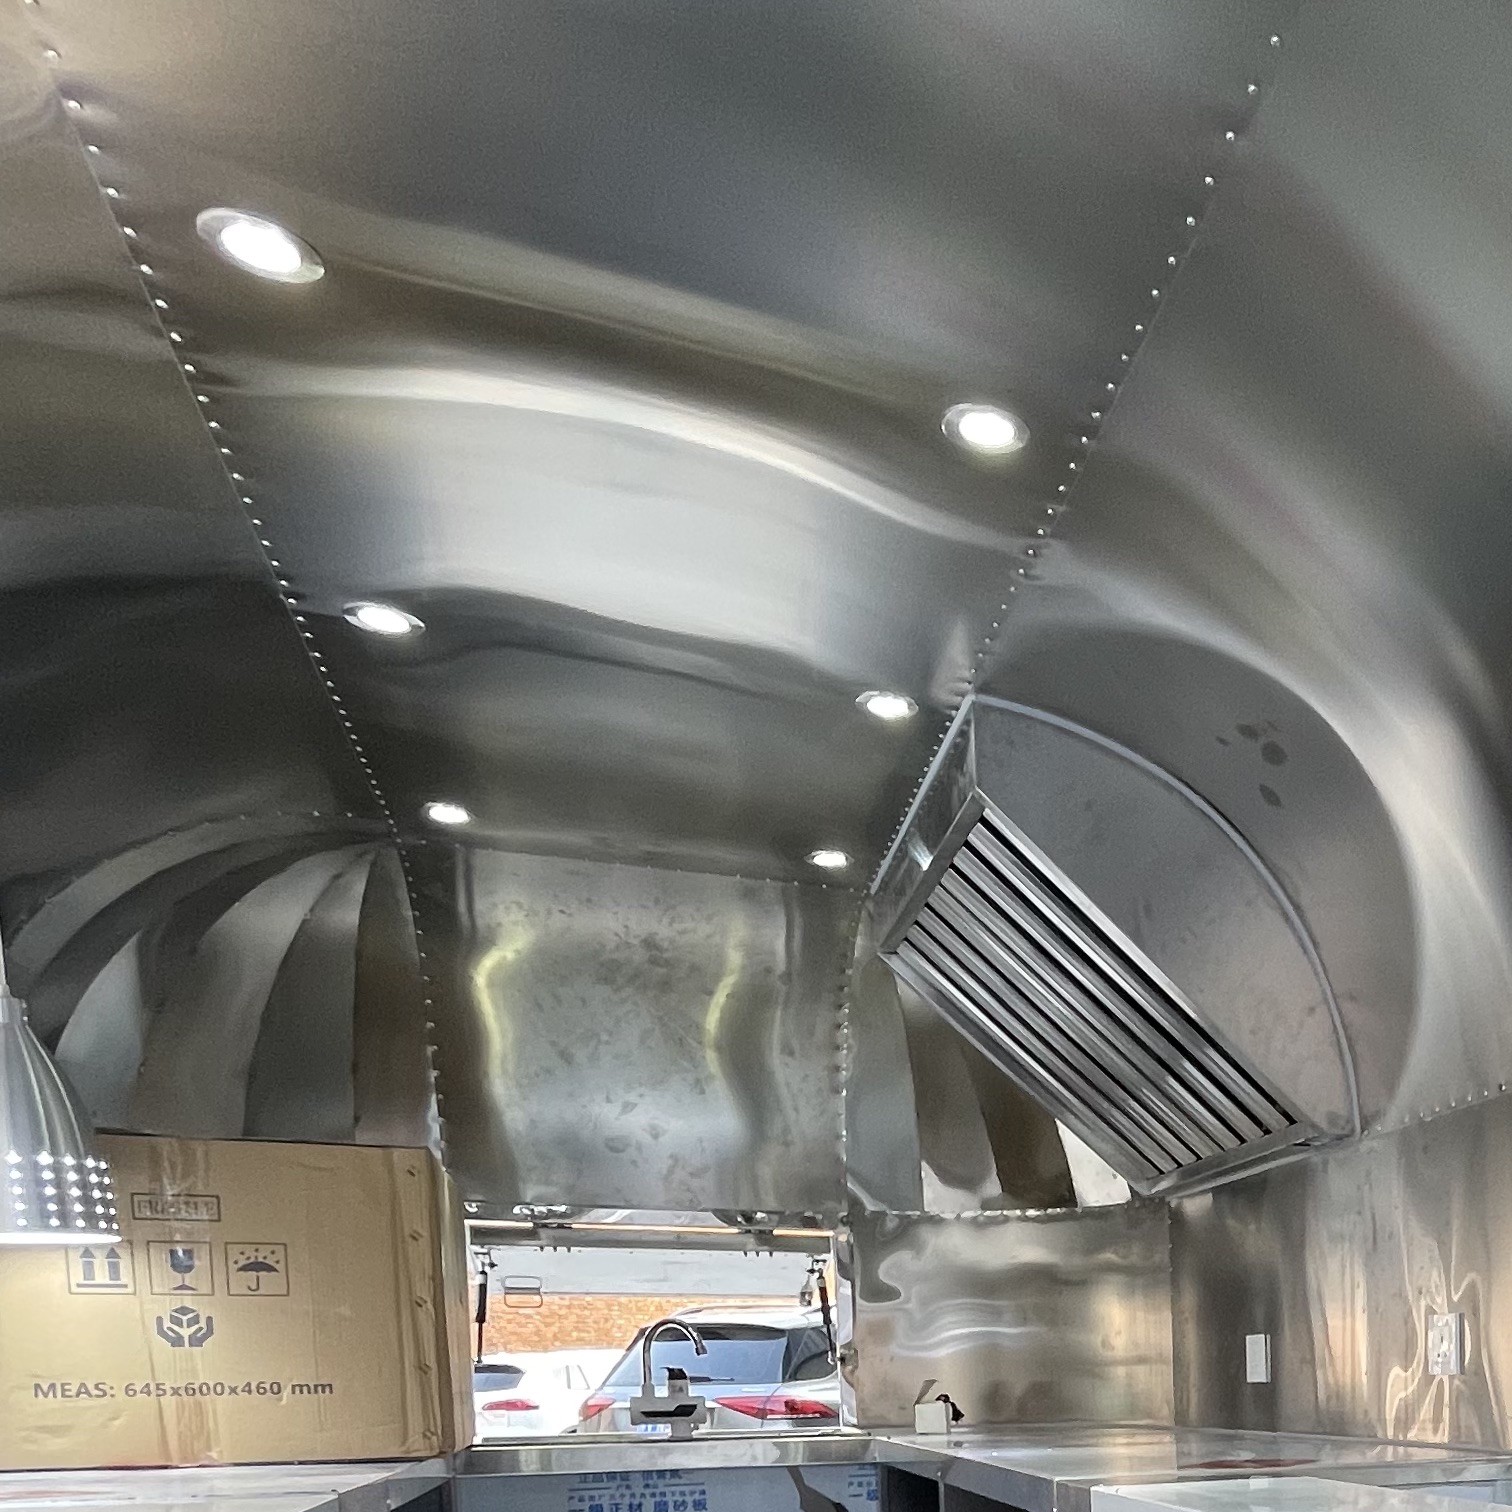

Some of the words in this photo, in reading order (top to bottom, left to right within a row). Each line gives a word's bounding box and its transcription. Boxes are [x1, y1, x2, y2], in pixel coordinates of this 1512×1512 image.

[33, 1381, 115, 1399] MEAS:
[124, 1380, 282, 1398] 645x600x460
[291, 1380, 334, 1396] mm
